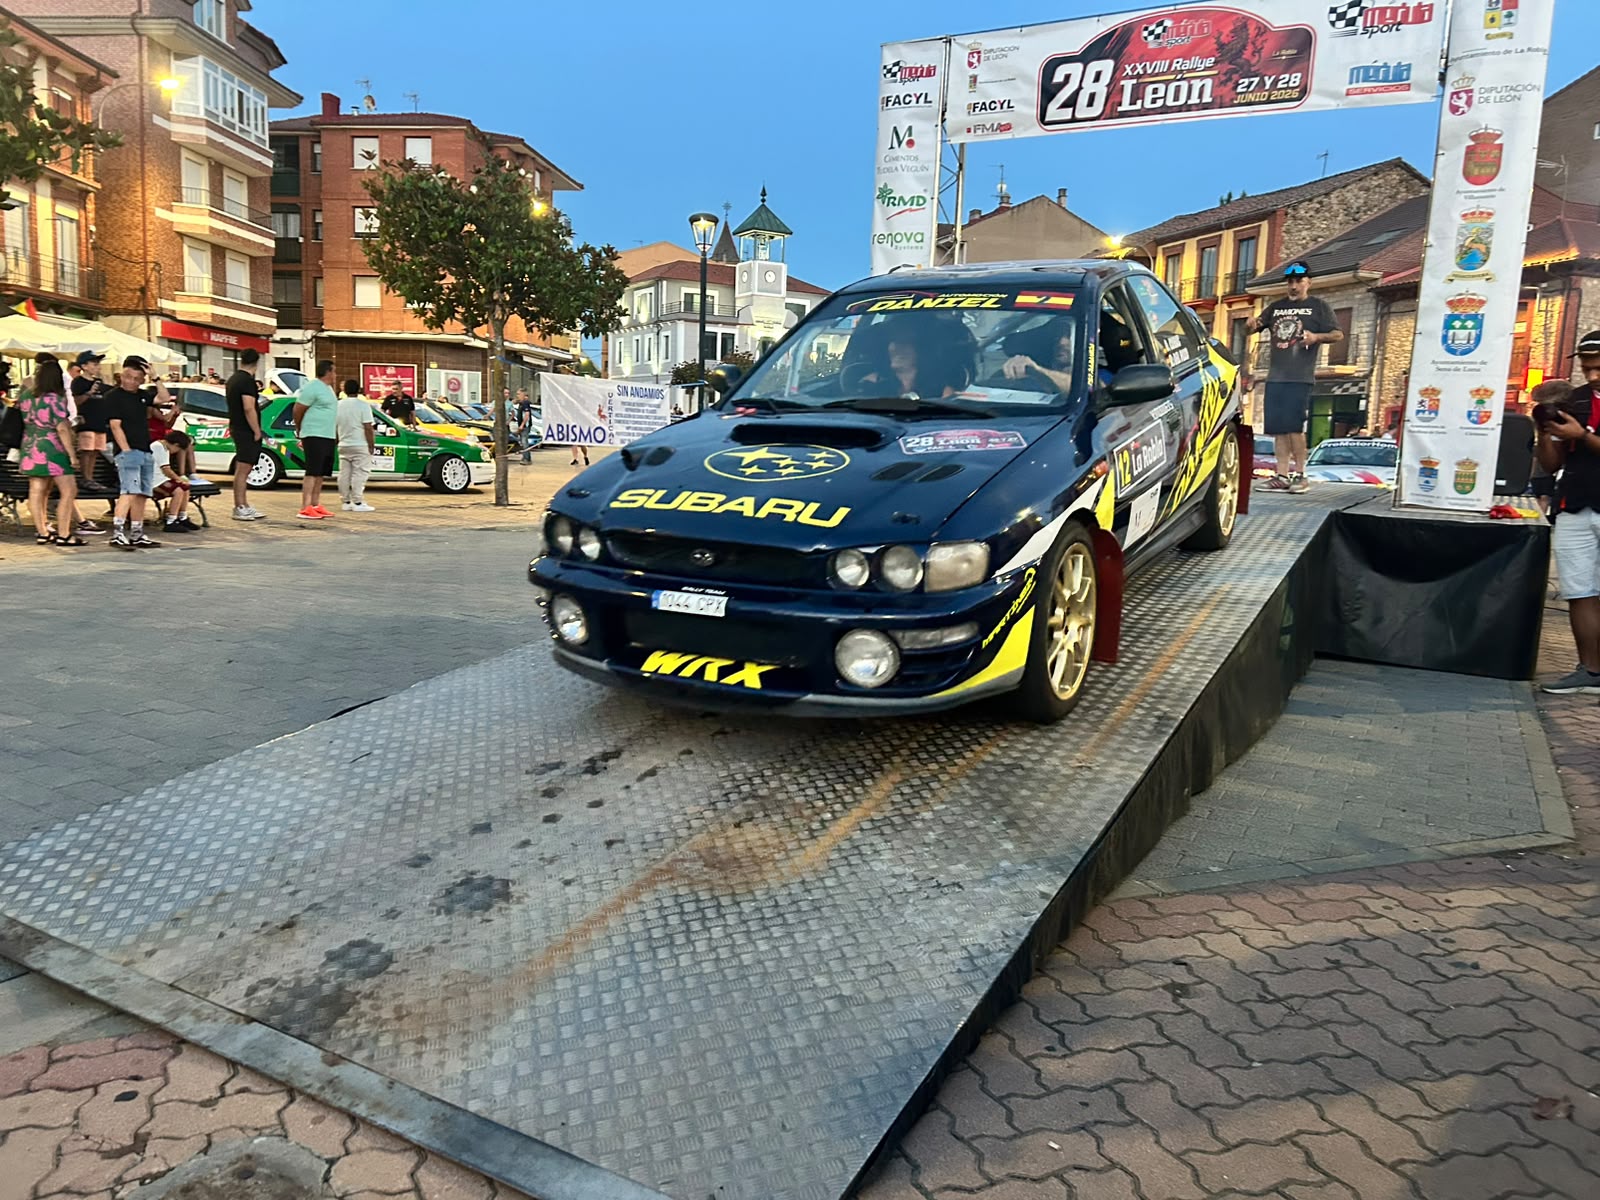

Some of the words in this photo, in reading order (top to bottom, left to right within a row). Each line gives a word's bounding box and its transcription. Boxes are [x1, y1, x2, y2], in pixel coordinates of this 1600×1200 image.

[1360, 21, 1403, 39] sport
[1122, 60, 1170, 77] XXVIII
[1170, 55, 1216, 72] Rallye
[1045, 59, 1116, 122] 28
[1236, 76, 1260, 93] 27
[1263, 74, 1276, 90] Y
[1276, 72, 1302, 89] 28
[1347, 84, 1410, 95] SERVICIOS
[1478, 83, 1541, 95] DIPUTACIÓN
[885, 92, 933, 107] FACYL
[1116, 72, 1214, 112] León
[1233, 91, 1269, 104] JUNIO
[1269, 88, 1300, 101] 2026
[1478, 95, 1491, 104] DE
[1493, 92, 1522, 103] LEÓN
[972, 99, 1015, 112] FACYL
[886, 195, 927, 207] RMD
[872, 232, 925, 248] renova
[867, 297, 1002, 312] DANIEL
[1273, 308, 1313, 316] RAMONES
[617, 384, 629, 397] SIN
[630, 386, 665, 400] ANDAMIOS
[545, 423, 606, 444] ABISMO
[906, 437, 934, 448] 28
[383, 447, 393, 456] 36
[1118, 449, 1132, 488] 12
[1132, 453, 1143, 476] La
[610, 488, 852, 528] SUBARU
[640, 651, 780, 689] WRX
